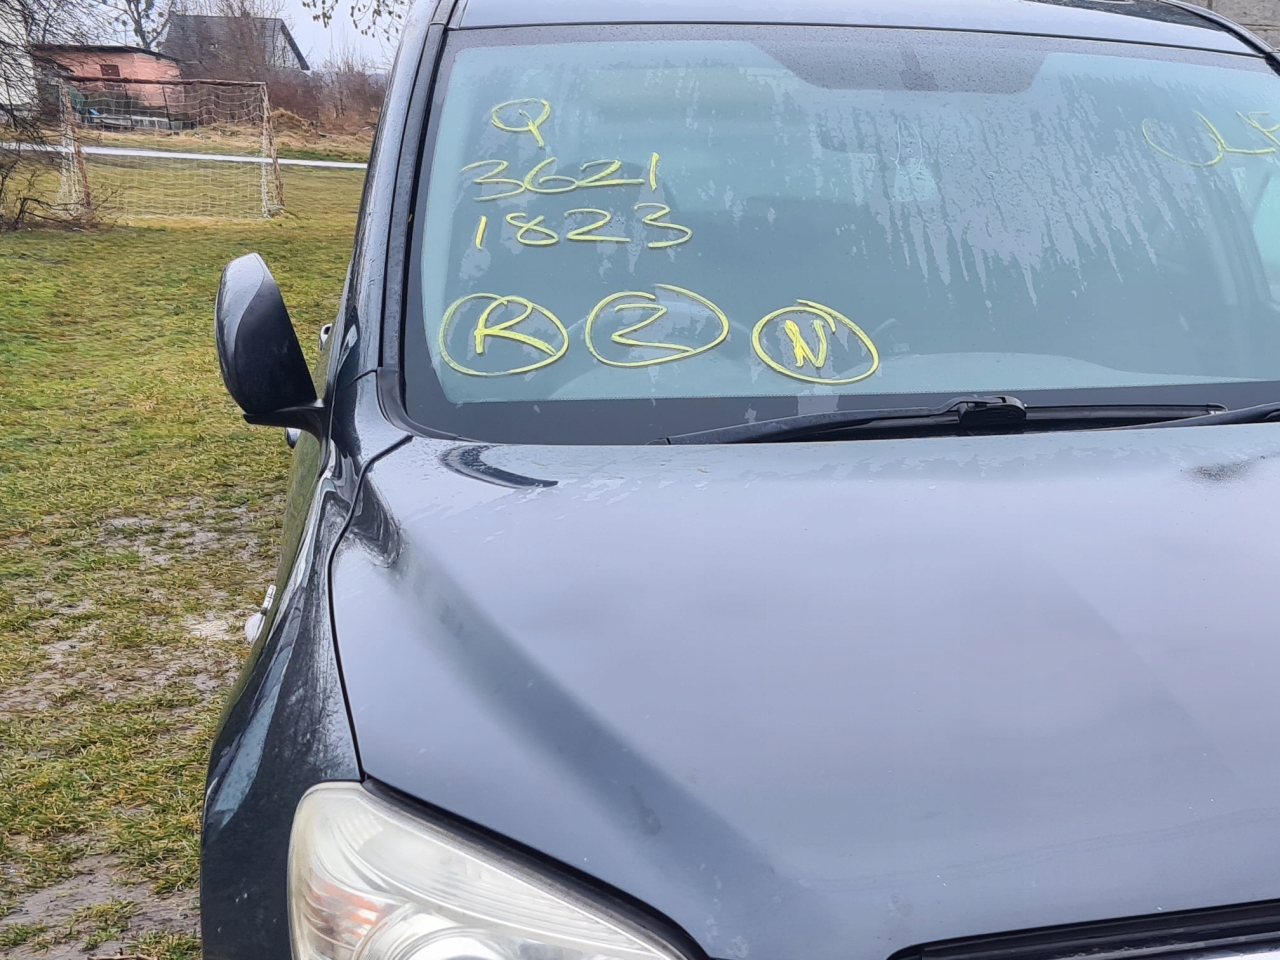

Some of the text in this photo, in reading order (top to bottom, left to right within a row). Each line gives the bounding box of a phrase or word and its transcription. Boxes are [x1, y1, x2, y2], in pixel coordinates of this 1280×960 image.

[459, 152, 660, 203] 3621
[475, 202, 693, 250] 1823
[474, 295, 558, 354] R
[784, 318, 832, 368] N
